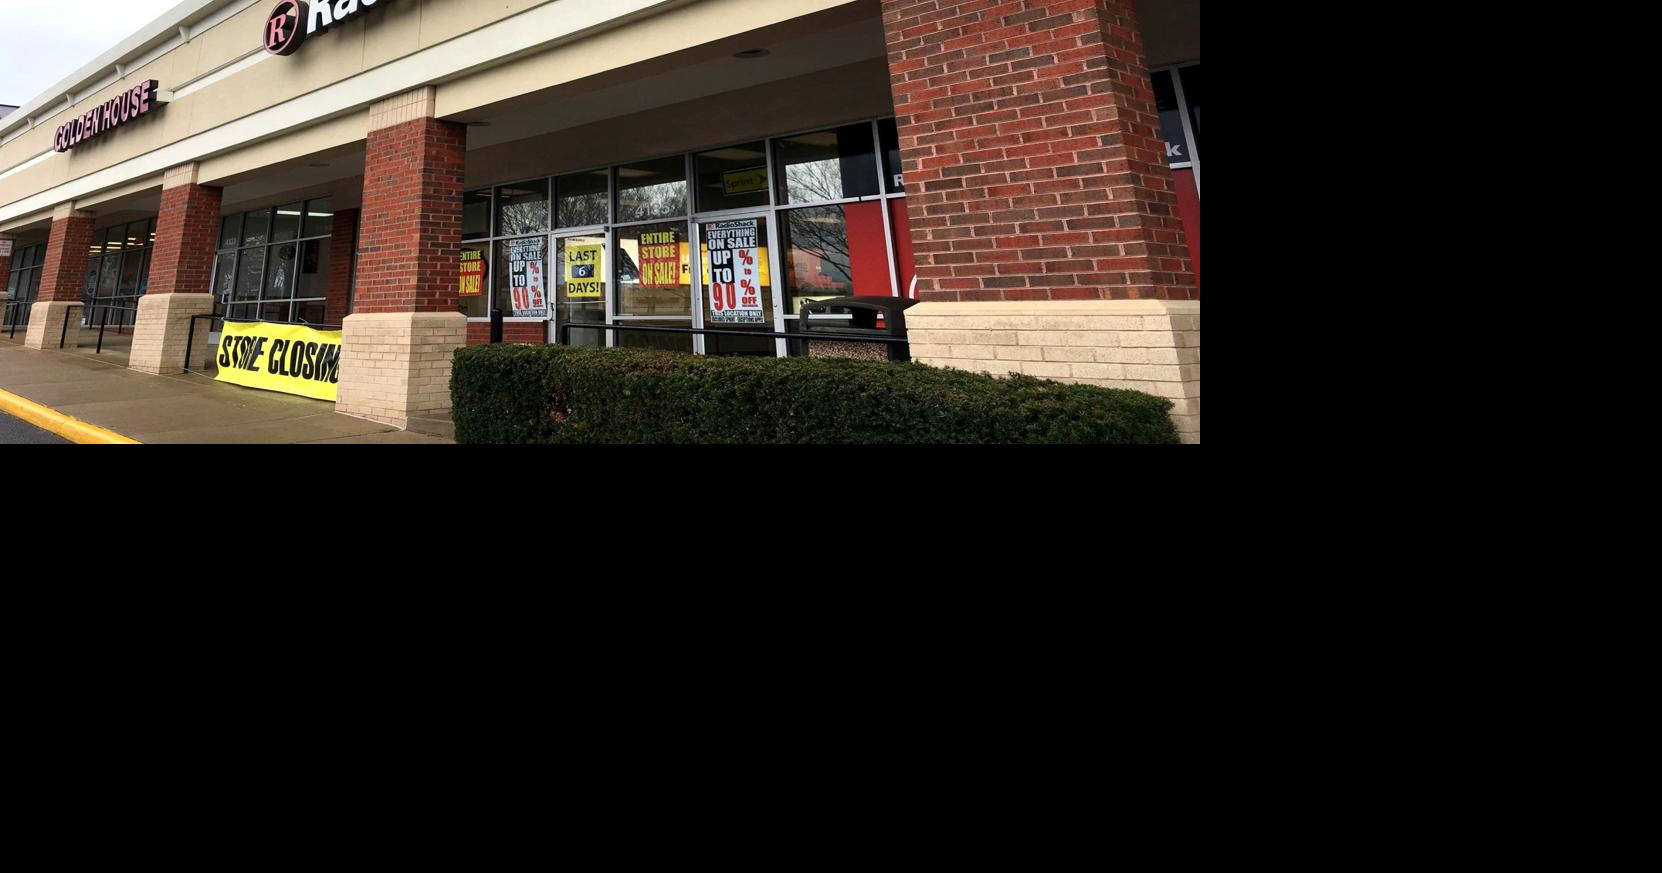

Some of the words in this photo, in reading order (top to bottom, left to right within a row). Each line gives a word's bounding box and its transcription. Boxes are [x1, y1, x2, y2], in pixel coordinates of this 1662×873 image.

[54, 105, 101, 152] GOLDEN
[102, 79, 153, 131] HOUSE
[716, 220, 754, 229] RadioShack
[641, 232, 675, 245] ENTIRE
[707, 228, 755, 239] EVERYTHING
[708, 239, 725, 250] ON
[727, 236, 756, 249] SALE
[511, 252, 522, 262] ON
[523, 250, 541, 261] SALE
[569, 250, 597, 262] LAST
[641, 245, 675, 259] STORE
[712, 250, 731, 265] UP
[738, 249, 753, 265] %
[513, 260, 525, 272] UP
[578, 266, 586, 277] 6
[642, 262, 653, 285] ON
[655, 261, 676, 285] SALE!
[513, 275, 525, 287] TO
[713, 268, 732, 283] TO
[568, 281, 599, 293] DAYS!
[740, 279, 755, 295] %
[513, 287, 529, 310] 90
[713, 282, 736, 311] 90
